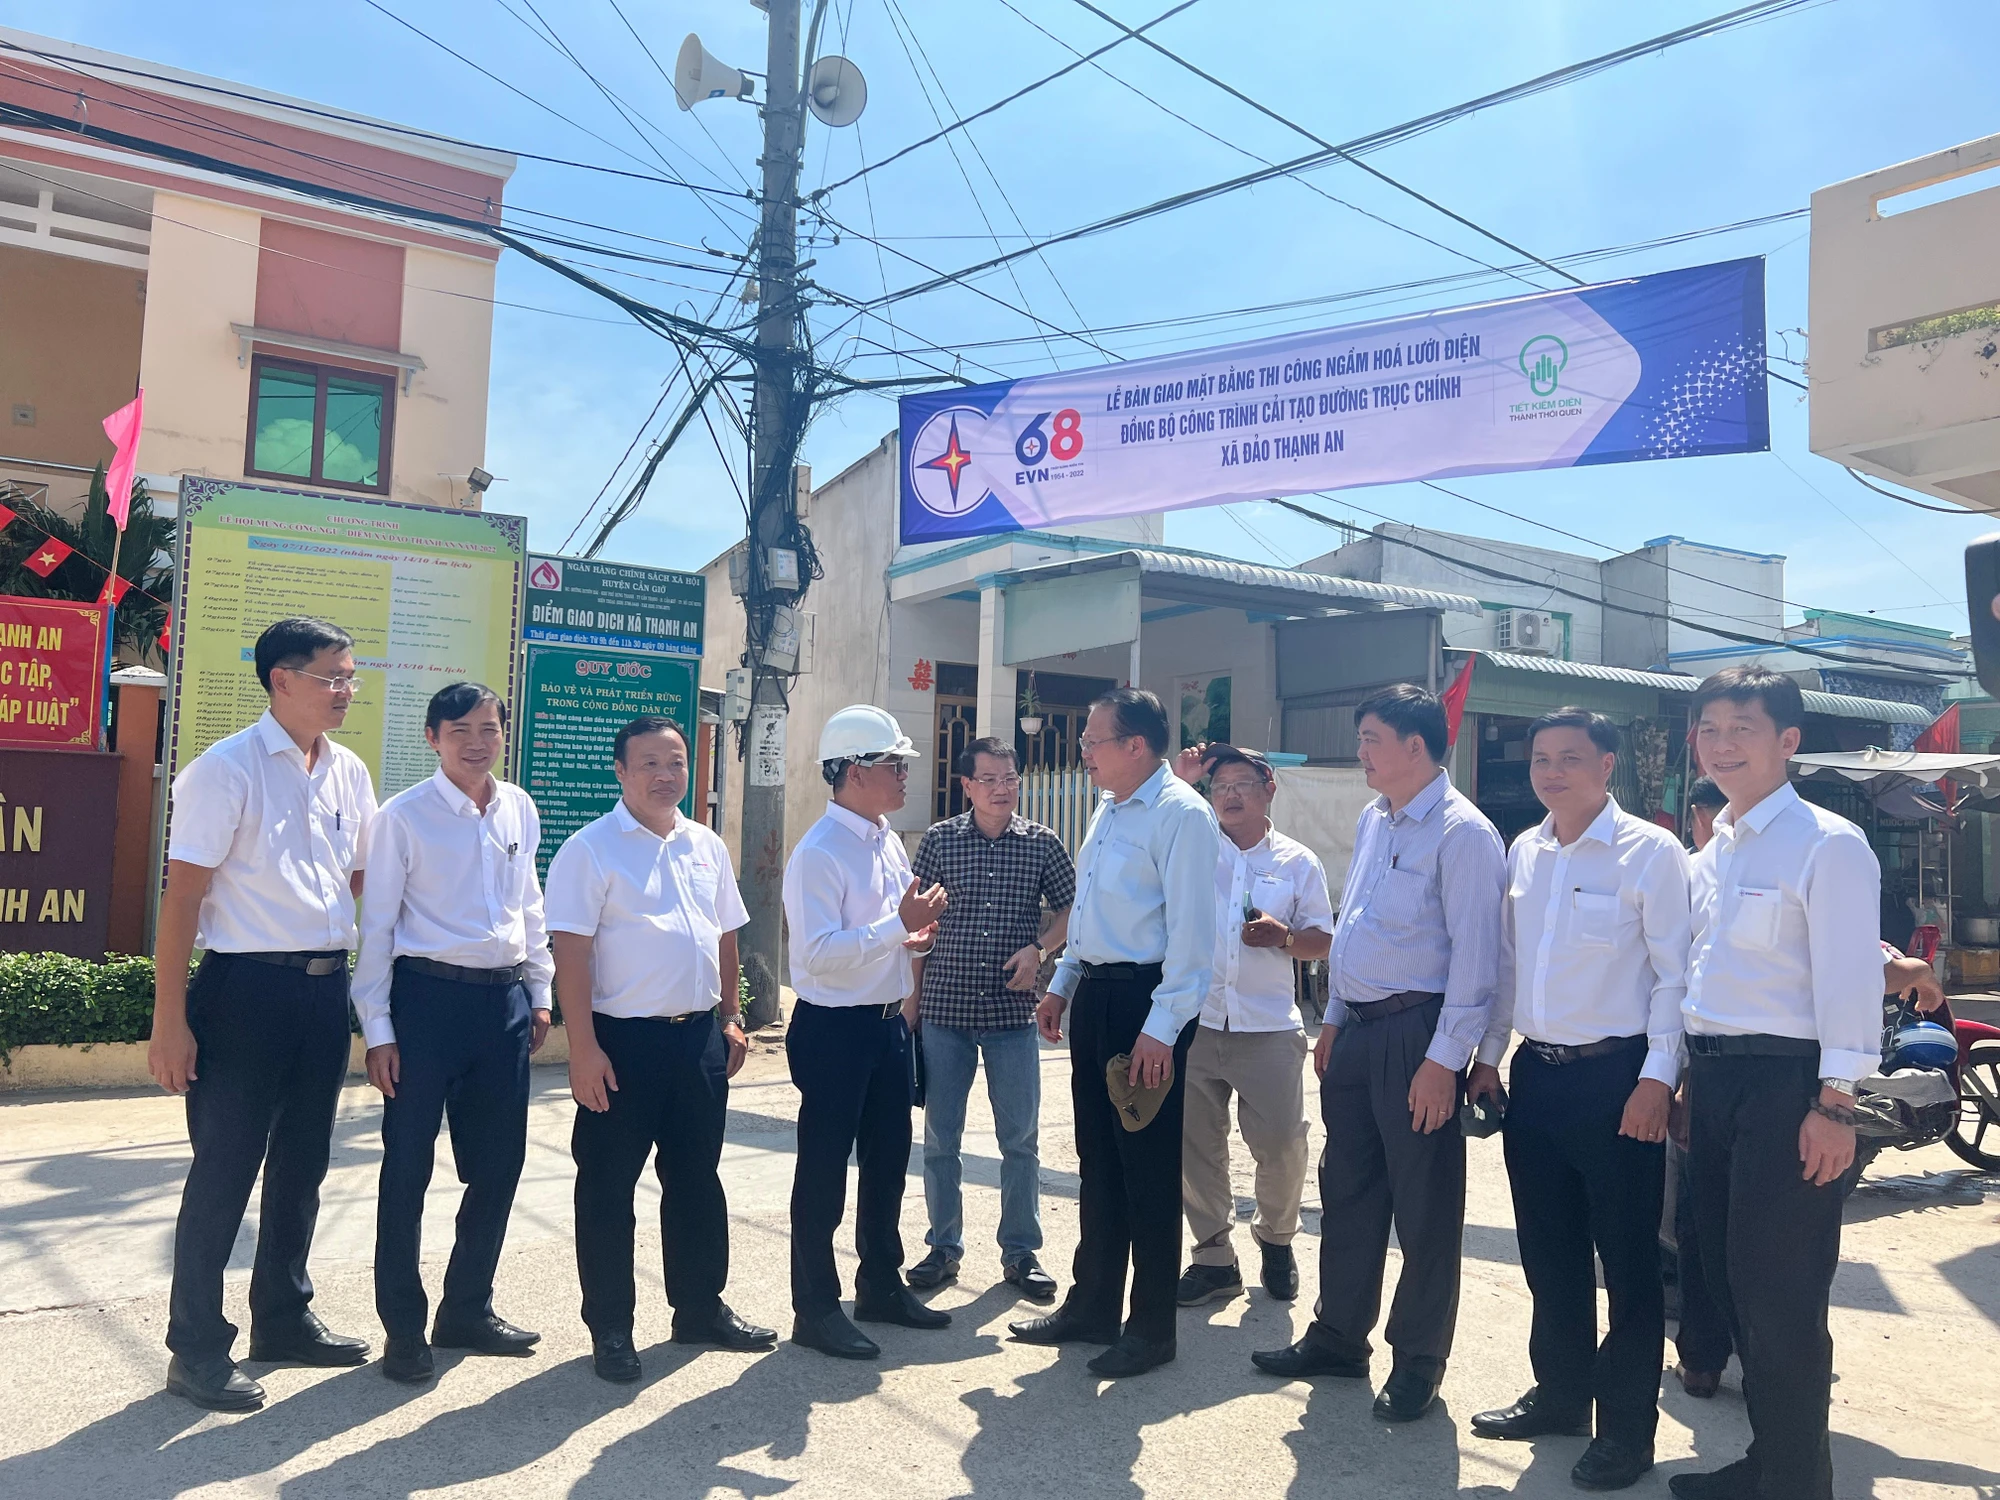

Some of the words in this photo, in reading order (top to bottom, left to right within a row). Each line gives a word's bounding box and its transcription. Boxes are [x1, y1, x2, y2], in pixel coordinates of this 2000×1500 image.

[1107, 385, 1121, 411] LỄ
[1124, 385, 1151, 408] BÀN
[1154, 382, 1183, 404] GIAO
[1187, 373, 1215, 401] MẶT
[1218, 366, 1254, 394] BẰNG
[1259, 366, 1279, 387] THI
[1284, 358, 1321, 383] CÔNG
[1326, 347, 1369, 377] NGẦM
[1373, 342, 1402, 370] HOÁ
[1407, 338, 1439, 365] LƯỚI
[1444, 333, 1480, 363] ĐIỆN
[1121, 415, 1154, 444] ĐỒNG
[1159, 413, 1175, 442] BỘ
[1179, 409, 1214, 435] CÔNG
[1219, 403, 1258, 430] TRÌNH
[1262, 394, 1284, 423] CẢI
[1289, 395, 1314, 423] TẠO
[1319, 386, 1368, 415] ĐƯỜNG
[1372, 382, 1410, 410] TRỤC
[1415, 374, 1461, 403] CHÍNH
[1559, 408, 1582, 417] QUEN
[1015, 408, 1083, 466] 68
[1221, 440, 1239, 467] XÃ
[1243, 434, 1269, 464] ĐẢO
[1274, 432, 1319, 462] THẠNH
[1324, 430, 1344, 453] AN
[1016, 468, 1049, 485] EVN
[1051, 472, 1065, 480] 1954
[1070, 470, 1084, 478] 2022
[235, 517, 254, 527] HỘI
[479, 544, 497, 554] 2022
[326, 515, 369, 527] CHƯƠNG
[370, 519, 400, 531] TRÌNH
[253, 539, 279, 551] Ngày
[282, 543, 338, 555] 07/11/2022
[376, 553, 400, 563] ngày
[403, 556, 429, 565] 14/10
[450, 560, 472, 570] lịch)
[567, 562, 591, 573] NGÂN
[593, 565, 617, 576] HÀNG
[619, 568, 646, 579] CHÍNH
[648, 571, 670, 583] SÁCH
[671, 574, 684, 584] XÃ
[685, 576, 700, 587] HỘI
[602, 579, 631, 591] HUYỆN
[632, 579, 650, 592] CẦN
[652, 584, 667, 594] GIỜ
[532, 599, 564, 625] ĐIỂM
[567, 608, 594, 628] GIAO
[597, 611, 625, 633] DỊCH
[627, 613, 642, 633] XÃ
[645, 616, 680, 639] THẠNH
[683, 621, 698, 639] AN
[37, 627, 62, 651] AN
[530, 629, 545, 639] Thời
[545, 631, 559, 641] gian
[560, 632, 573, 642] giao
[573, 633, 589, 643] dịch:
[590, 635, 599, 644] Từ
[608, 636, 620, 647] đến
[621, 638, 632, 648] 11h
[633, 639, 642, 648] 30
[642, 641, 656, 651] ngày
[656, 642, 665, 651] 09
[665, 642, 680, 653] hàng
[680, 644, 697, 655] tháng
[19, 658, 53, 692] TẬP,
[370, 661, 394, 670] ngày
[397, 662, 424, 671] 15/10
[576, 659, 613, 677] QUY
[616, 661, 653, 679] ƯỚC
[541, 681, 561, 694] BẢO
[564, 684, 577, 695] VỆ
[580, 685, 593, 696] VÀ
[596, 688, 622, 699] PHÁT
[625, 687, 653, 701] TRIỂN
[656, 691, 682, 703] RỪNG
[546, 698, 579, 709] TRONG
[582, 699, 609, 711] CỘNG
[612, 699, 638, 713] ĐỒNG
[641, 703, 662, 715] DÂN
[663, 706, 677, 716] CƯ
[38, 889, 85, 922] AN
